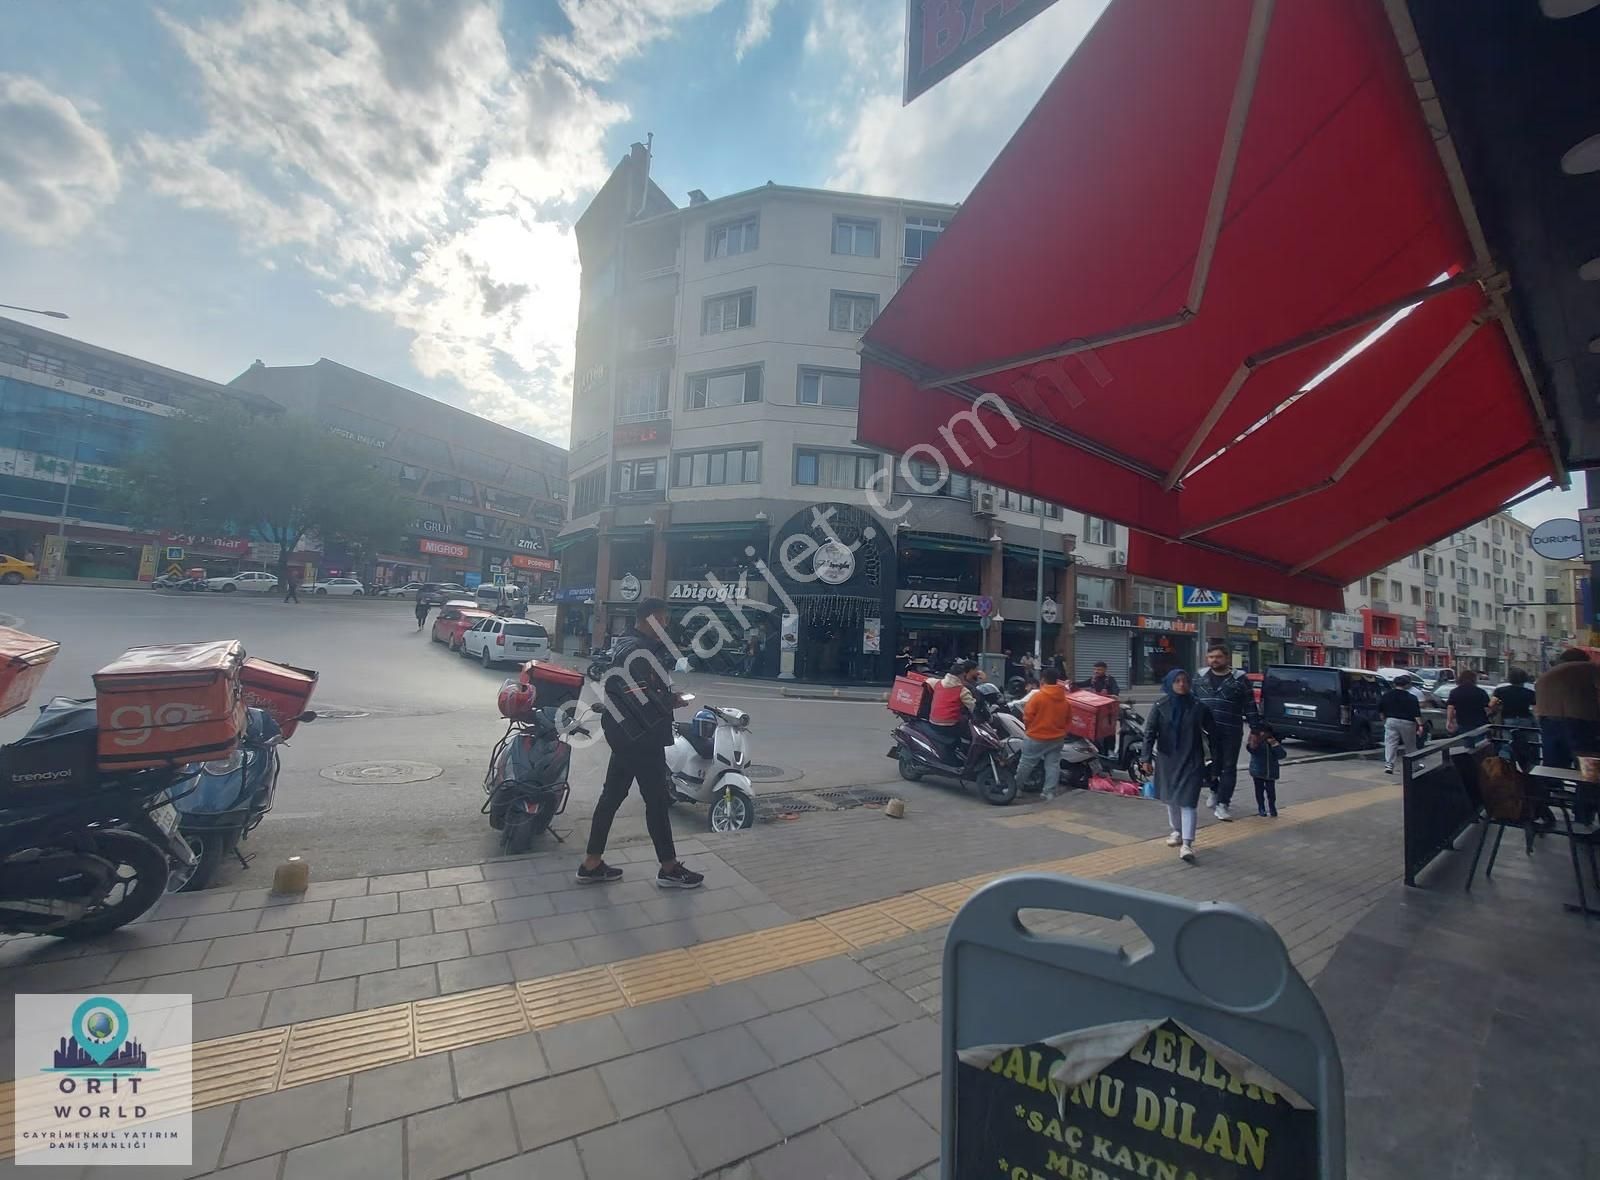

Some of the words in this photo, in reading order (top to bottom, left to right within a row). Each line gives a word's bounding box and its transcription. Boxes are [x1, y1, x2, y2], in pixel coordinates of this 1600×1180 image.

[425, 541, 464, 557] MIGROS
[669, 582, 747, 603] Abişoğlu
[1092, 614, 1109, 626] Has
[1110, 616, 1131, 627] Altın
[12, 768, 72, 784] trendyol
[1133, 1086, 1270, 1171] DİLAN
